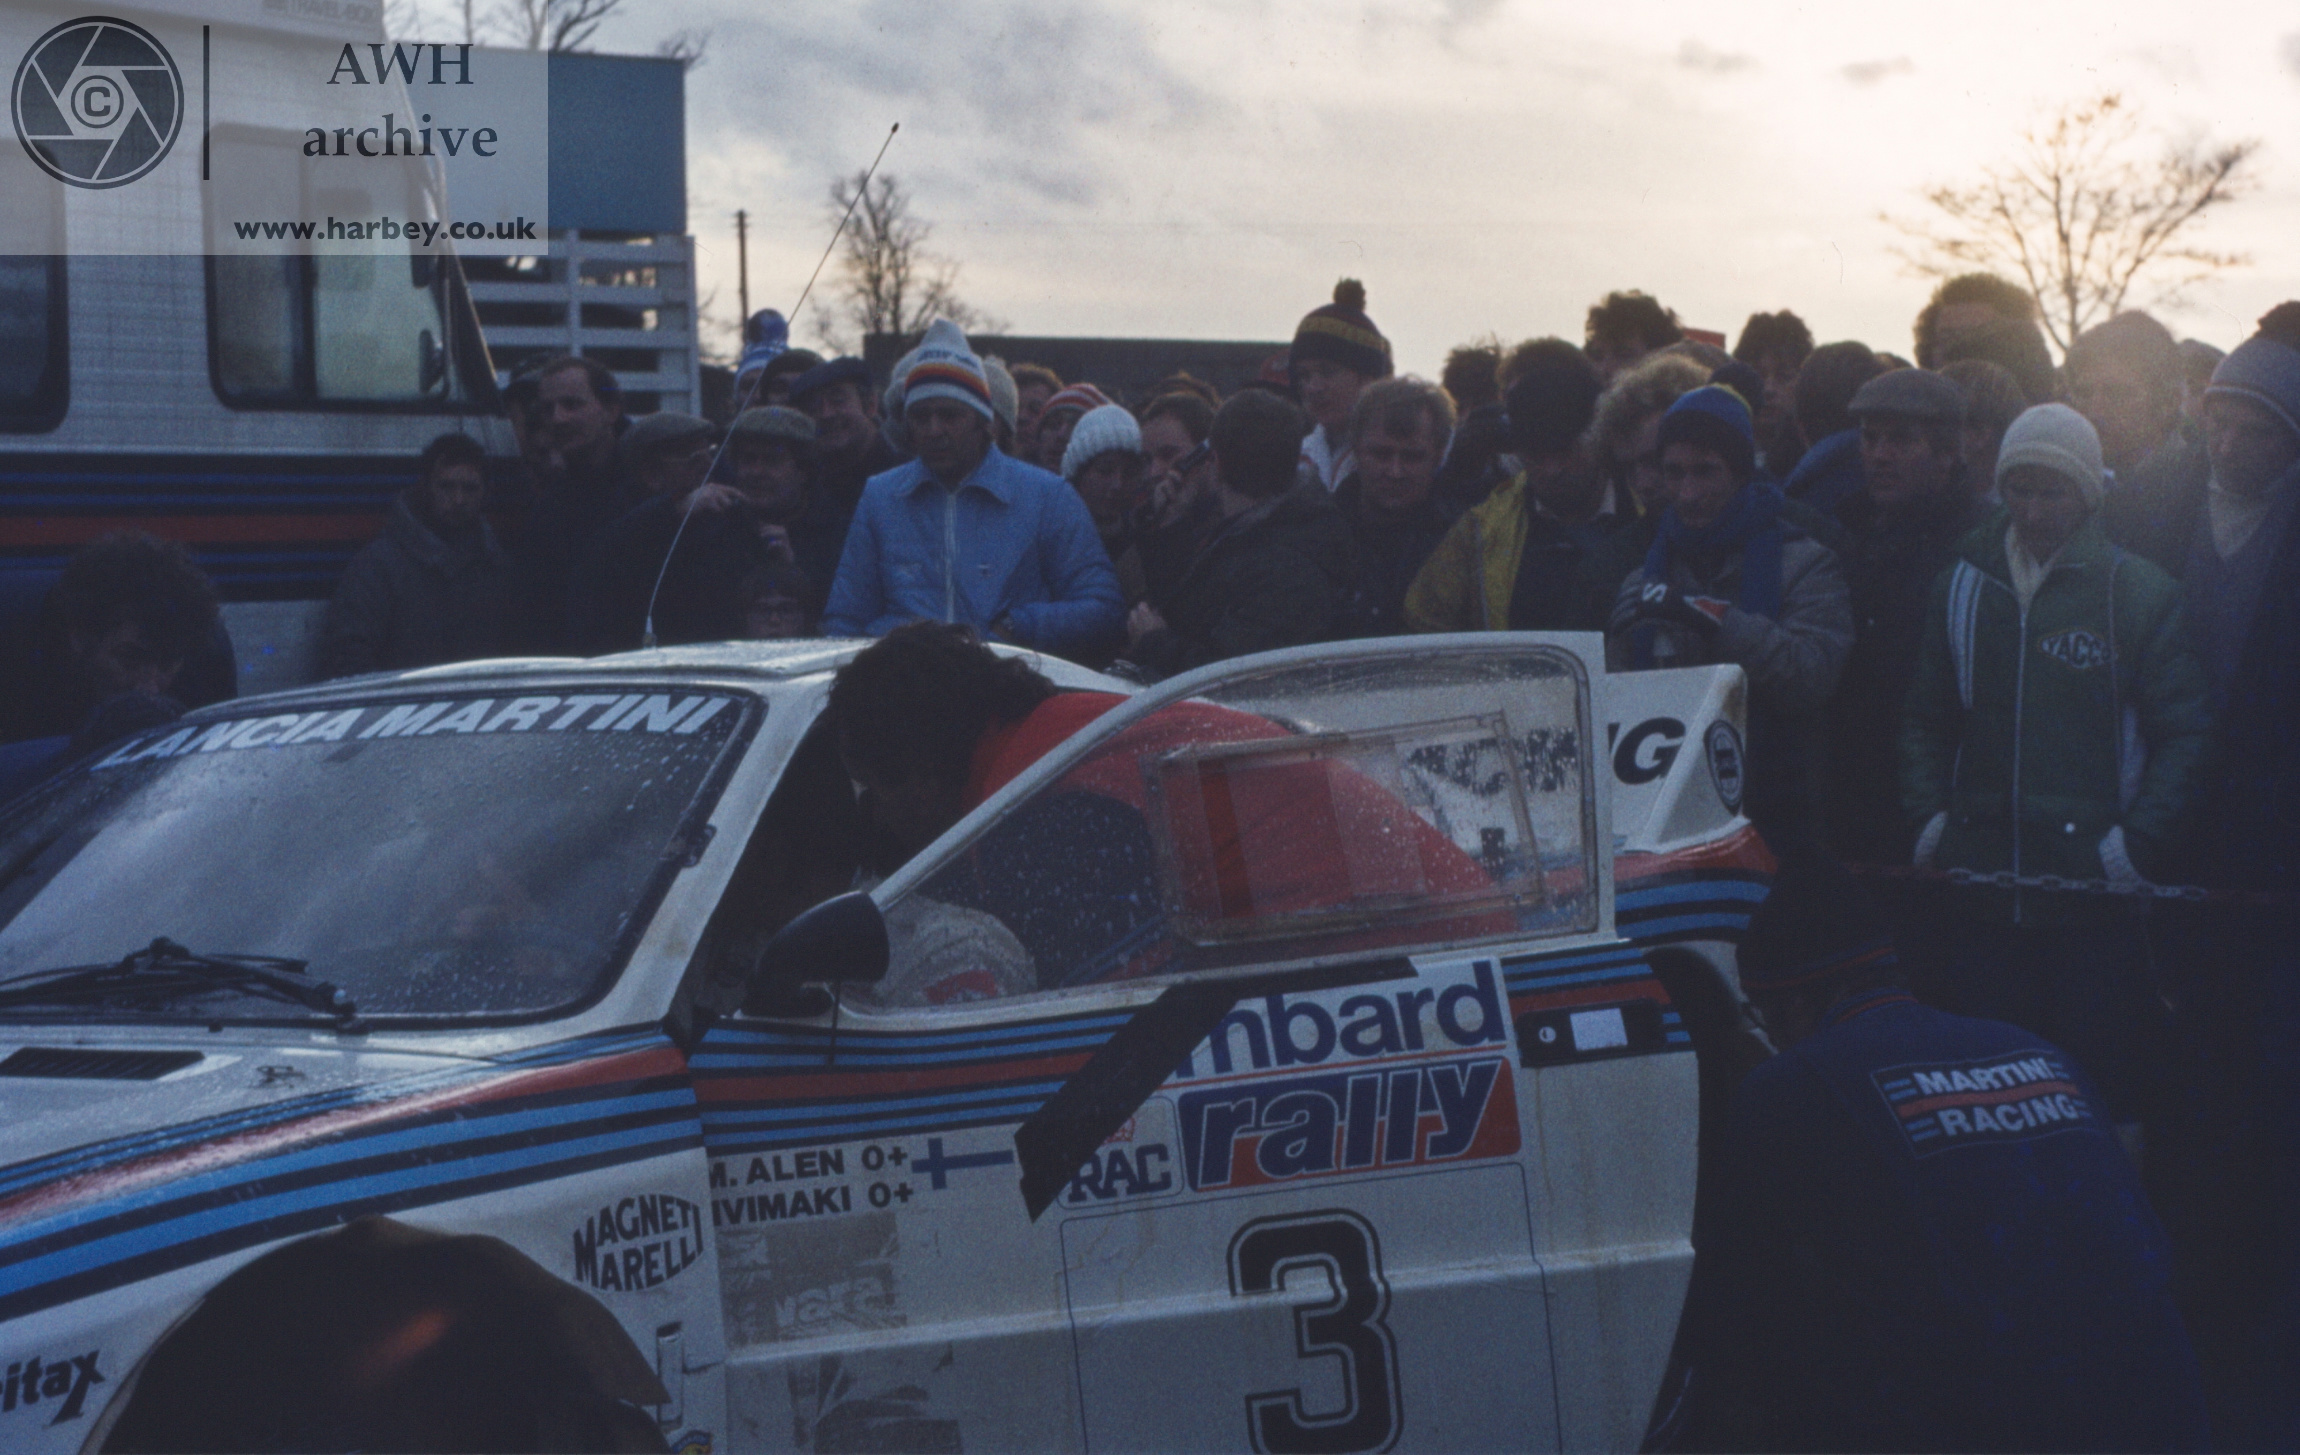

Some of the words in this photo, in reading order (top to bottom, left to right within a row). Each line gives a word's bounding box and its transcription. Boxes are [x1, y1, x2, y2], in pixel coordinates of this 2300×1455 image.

[90, 707, 365, 771] LANCIA
[357, 694, 729, 740] MARTINI
[1913, 1057, 2056, 1096] MARTINI
[1200, 1058, 1502, 1186] rally
[1937, 1093, 2079, 1136] RACING
[747, 1149, 845, 1186] ALEN
[1068, 1144, 1173, 1202] RAC
[573, 1193, 703, 1262] MAGNETI
[573, 1230, 703, 1291] MARELLI
[1226, 1208, 1404, 1455] 3
[0, 1350, 106, 1428] itax
